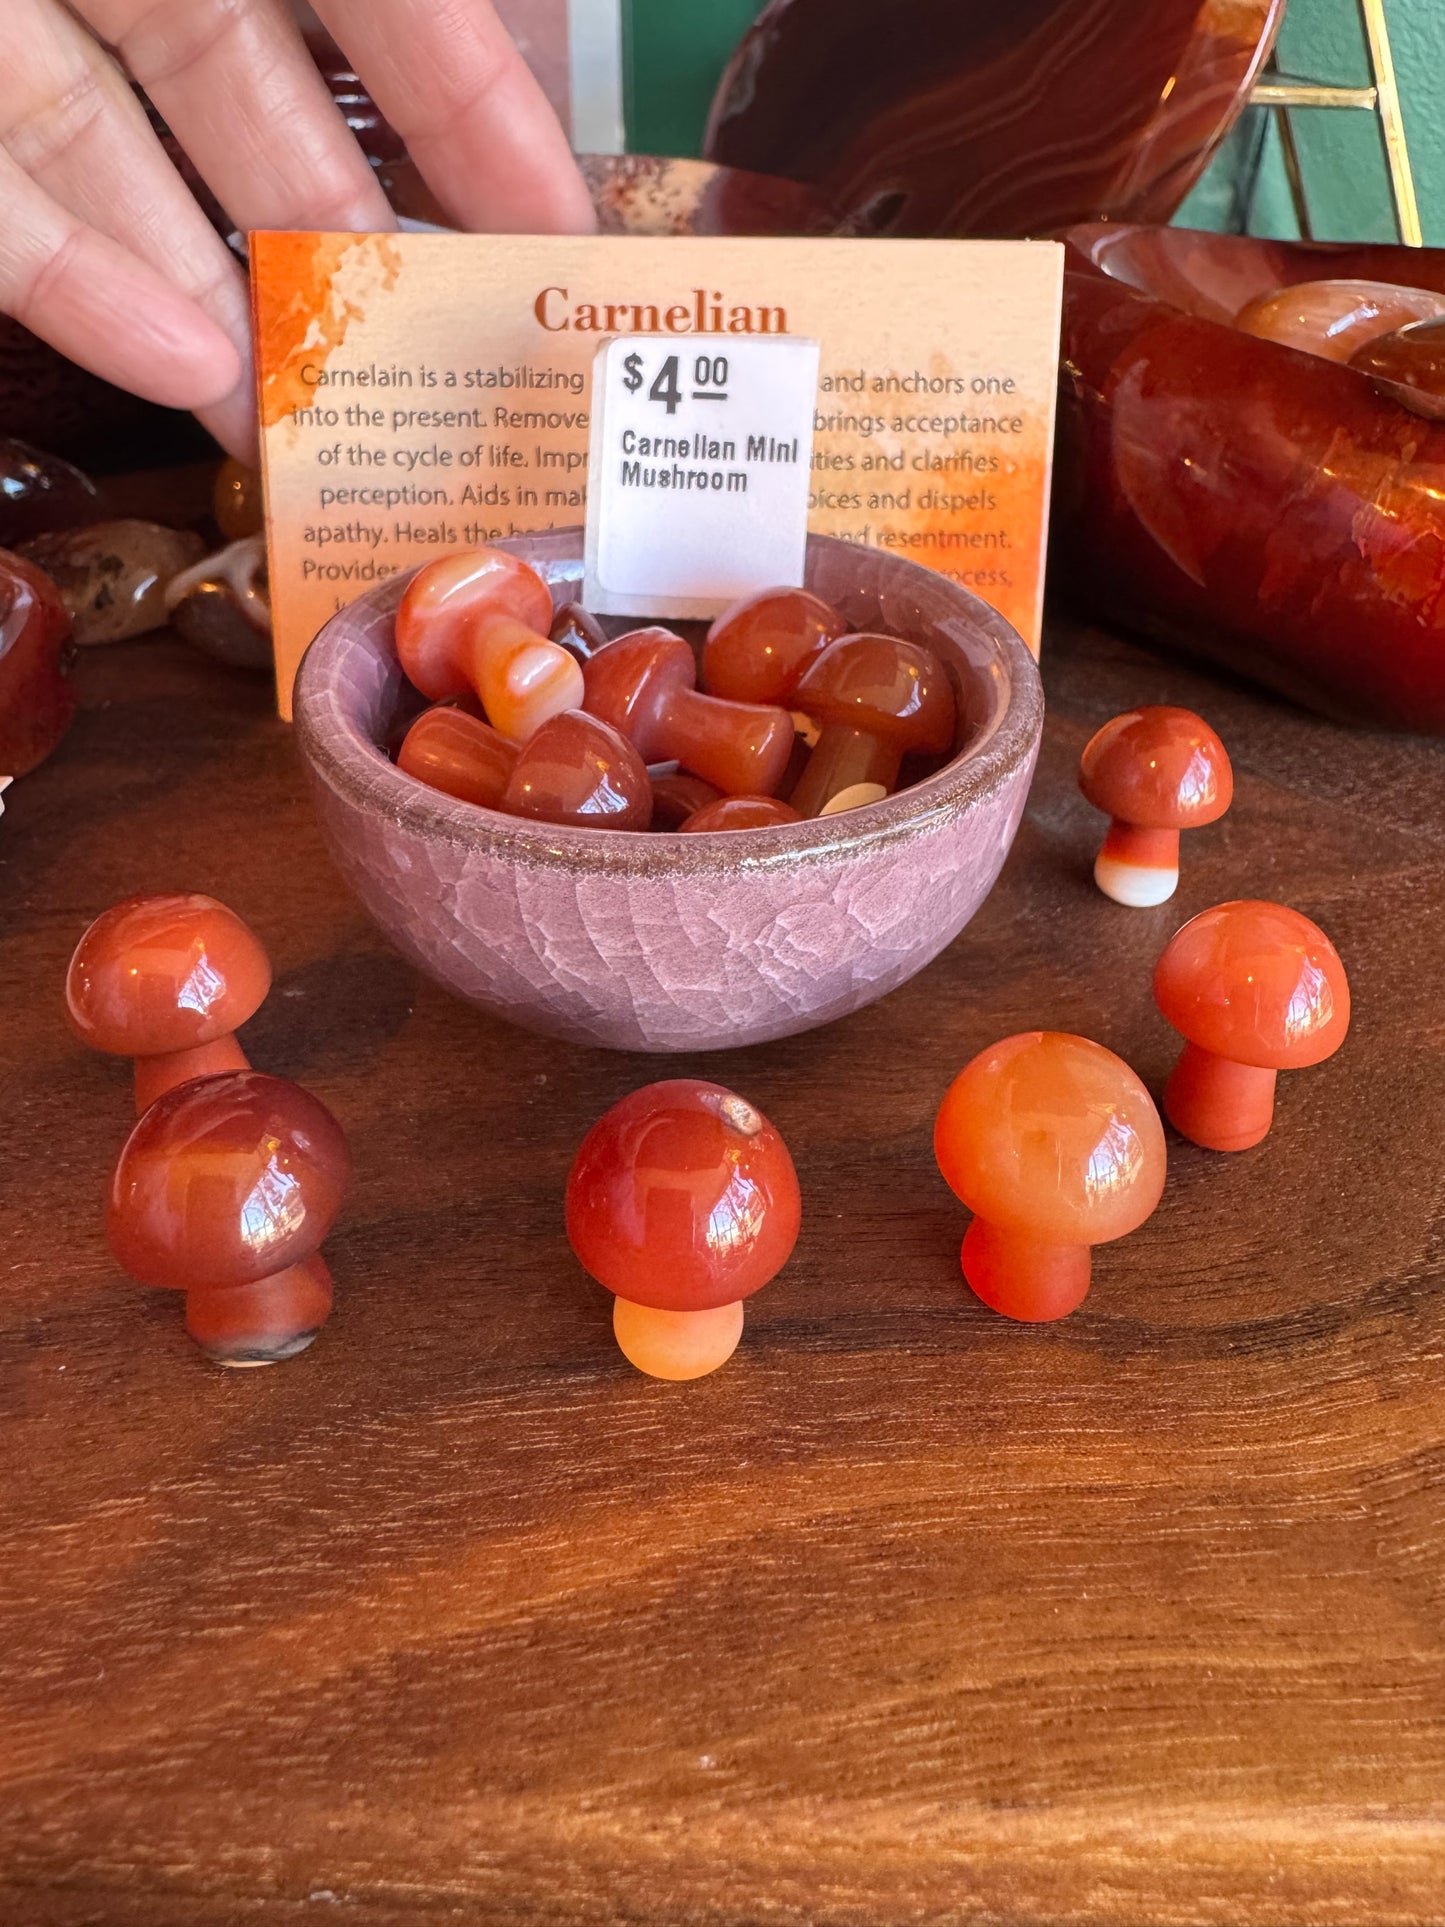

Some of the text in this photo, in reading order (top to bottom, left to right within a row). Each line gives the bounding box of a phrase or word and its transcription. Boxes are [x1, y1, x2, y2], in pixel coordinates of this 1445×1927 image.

[533, 286, 790, 334] Carnelian
[300, 363, 1016, 396] Carnelain is a stabilizing and anchors one
[292, 403, 1024, 439] into the present. Remove brings acceptance
[318, 443, 342, 467] of
[346, 443, 388, 467] the
[393, 443, 454, 473] cycle
[459, 443, 485, 468] of
[861, 450, 905, 472] and
[911, 448, 999, 473] clarifies
[622, 430, 736, 460] Carnelian
[621, 461, 748, 493] Mushroom
[320, 483, 454, 511] perception.
[461, 483, 511, 507] Aids
[517, 485, 538, 507] in
[867, 488, 911, 511] and
[918, 488, 997, 515] dispels
[303, 519, 388, 549] apathy.
[395, 520, 458, 545] Heals
[464, 520, 502, 543] the
[876, 529, 1011, 549] resentment.
